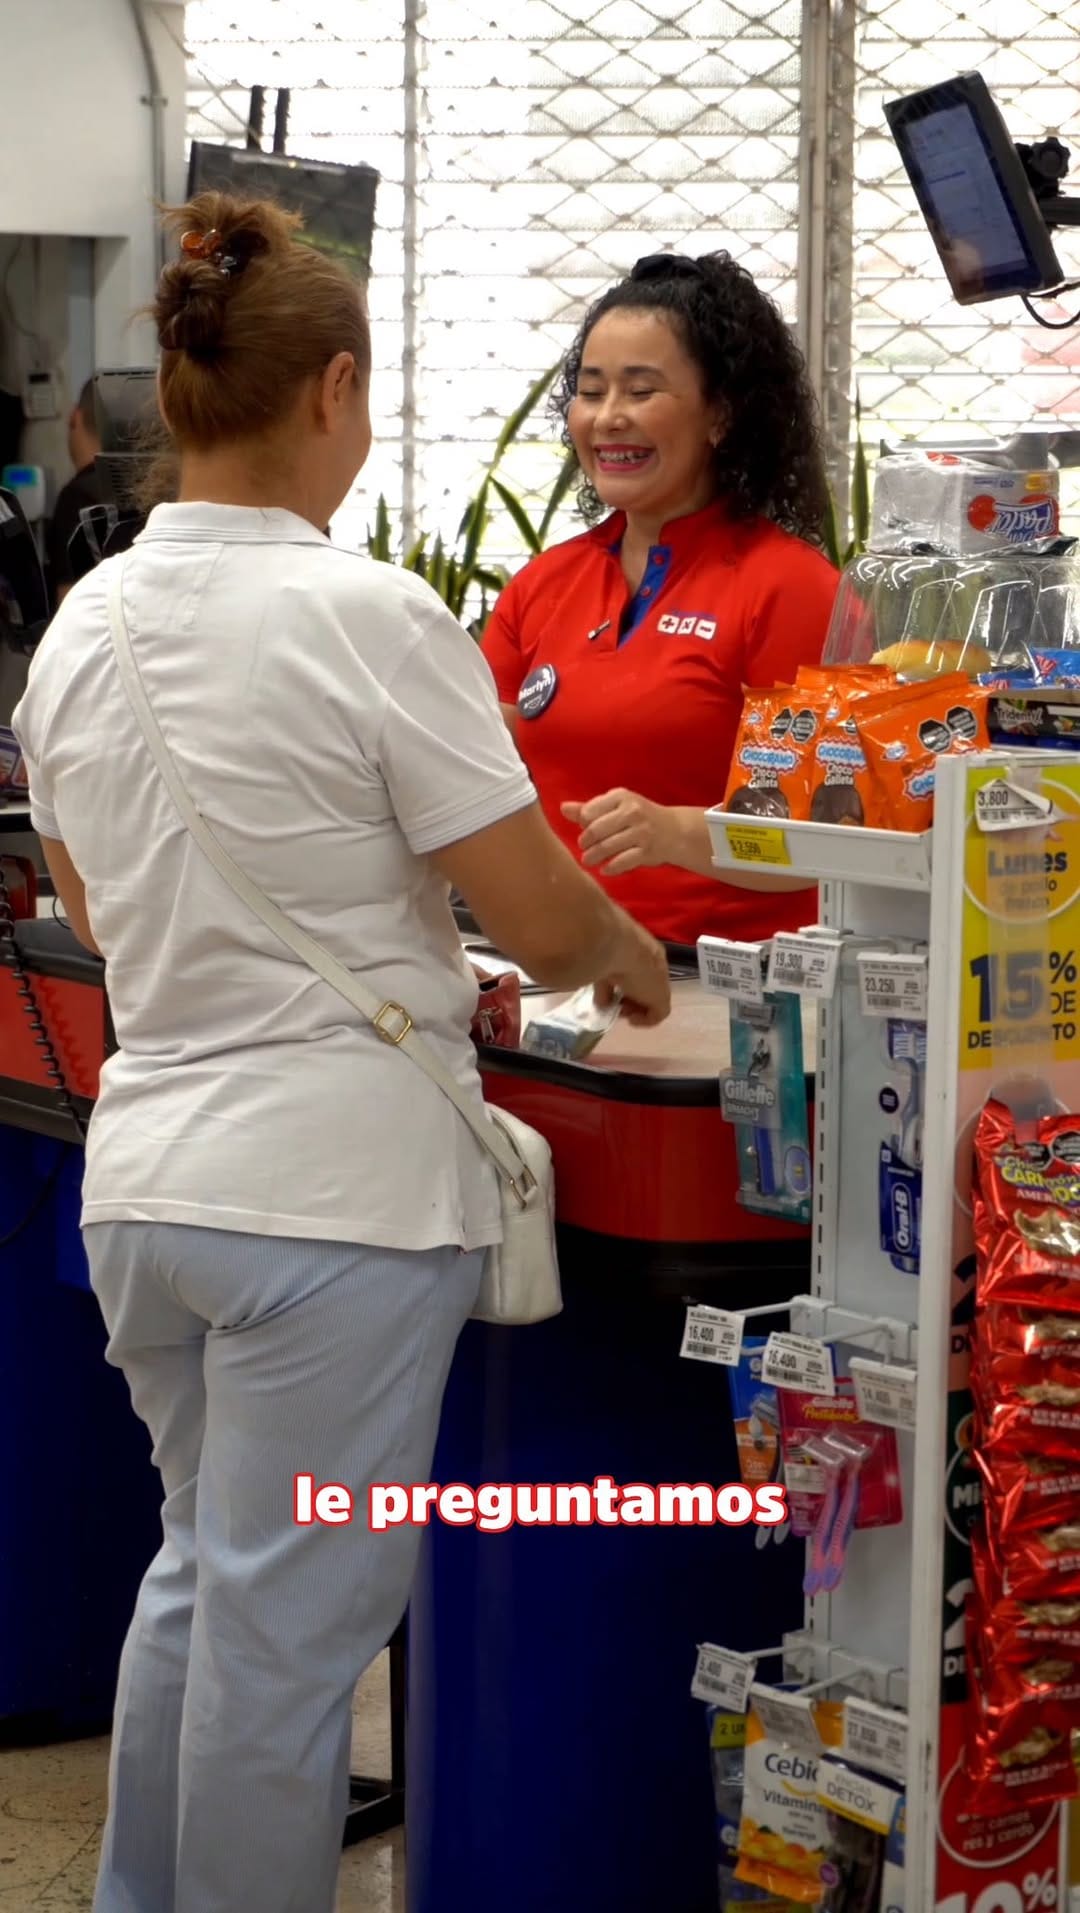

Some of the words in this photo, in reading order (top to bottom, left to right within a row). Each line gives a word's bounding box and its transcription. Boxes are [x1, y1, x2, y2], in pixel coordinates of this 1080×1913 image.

[752, 766, 777, 778] Choco
[826, 764, 853, 777] Choco
[748, 776, 778, 789] Galleta
[824, 774, 854, 787] Galleta
[988, 850, 1068, 876] Lunes
[724, 1079, 775, 1105] Gillette
[894, 1189, 910, 1247] Oral-B
[827, 1781, 876, 1814] DETOX
